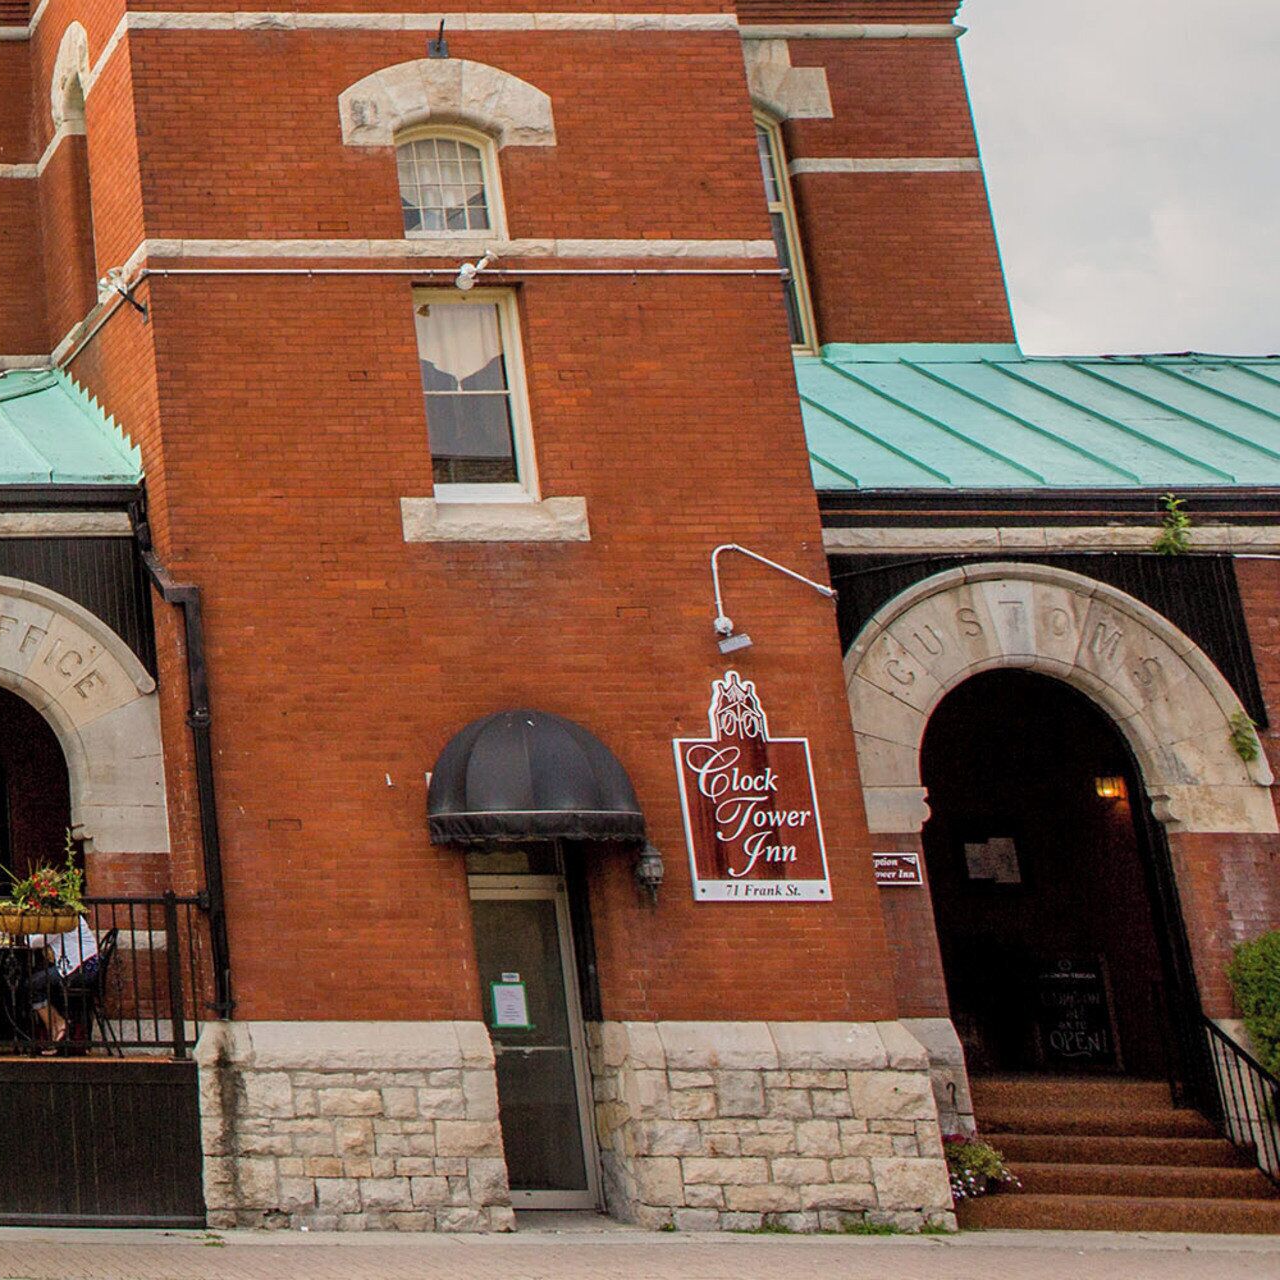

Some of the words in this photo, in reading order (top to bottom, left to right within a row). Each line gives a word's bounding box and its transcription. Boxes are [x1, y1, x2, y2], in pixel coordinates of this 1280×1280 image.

[886, 601, 1162, 688] CUSTOMS
[686, 744, 779, 804] Clock
[716, 795, 811, 842] Tower
[728, 831, 798, 878] Inn
[899, 869, 915, 879] Inn
[726, 884, 739, 896] 71
[744, 884, 781, 897] Frank
[786, 885, 801, 897] St.
